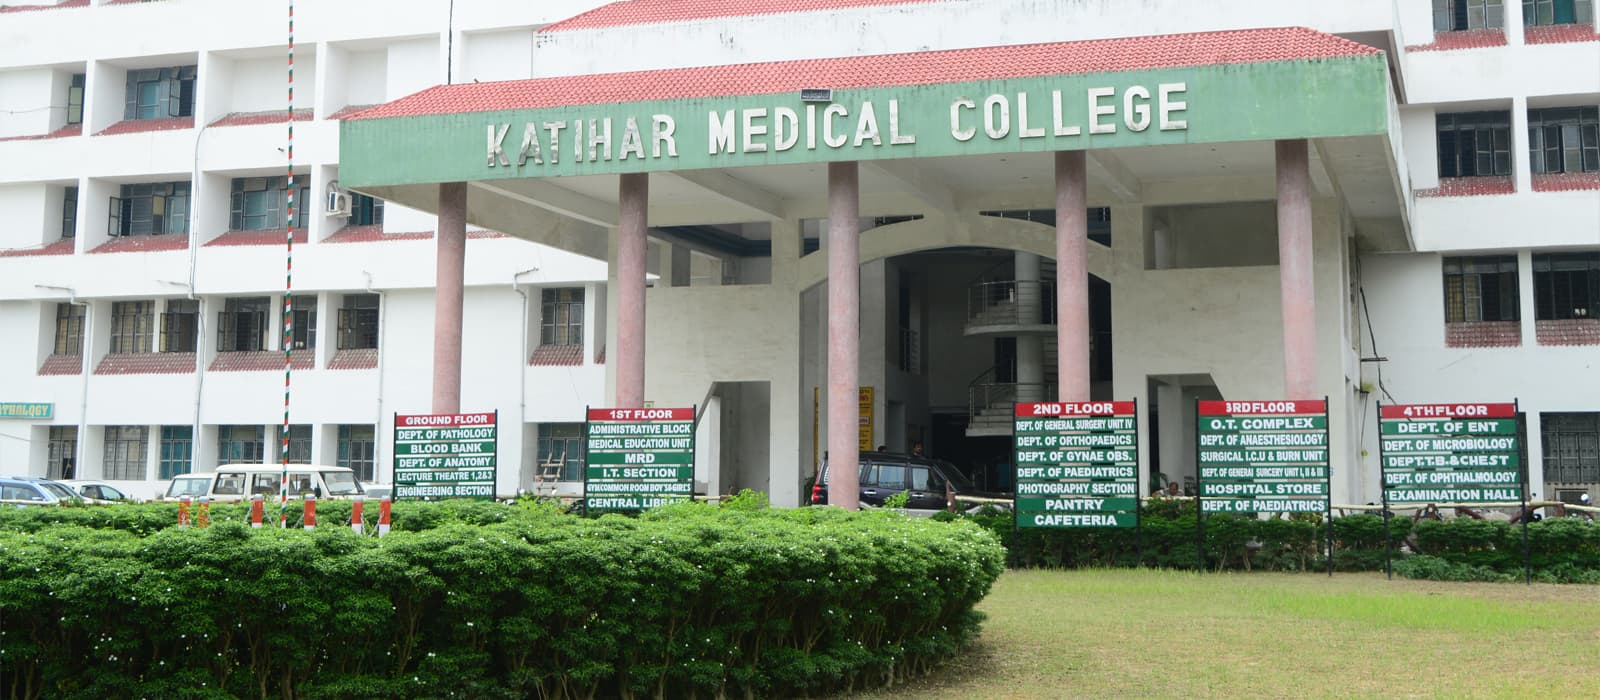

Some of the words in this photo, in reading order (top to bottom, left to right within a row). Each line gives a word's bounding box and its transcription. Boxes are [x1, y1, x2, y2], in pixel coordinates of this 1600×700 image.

[487, 114, 678, 167] KATIHAR
[708, 100, 916, 154] MEDICAL
[950, 82, 1187, 141] COLLEGE
[1033, 404, 1061, 414] 2ND
[1066, 404, 1114, 414] FLOOR
[1226, 403, 1250, 412] 3RD
[1252, 402, 1295, 412] FLOOR
[610, 410, 631, 419] 1ST
[634, 410, 672, 418] FLOOR
[406, 416, 451, 425] GROUND
[454, 415, 487, 424] FLOOR
[1016, 421, 1033, 430] DEPT.
[1036, 421, 1043, 430] OF
[1045, 420, 1074, 430] GENERAL
[1076, 420, 1105, 430] SURGERY
[1108, 419, 1124, 428] UNIT
[1125, 419, 1132, 428] IV
[1211, 420, 1238, 429] O.T.
[1242, 418, 1314, 429] COMPLEX
[590, 425, 660, 434] ADMINISTRATIVE
[663, 424, 690, 433] BLOCK
[1398, 423, 1439, 432] DEPT.
[1444, 422, 1463, 432] OF
[1468, 422, 1498, 432] ENT
[398, 430, 423, 439] DEPT.
[426, 430, 439, 439] OF
[441, 428, 493, 438] PATHOLOGY
[589, 439, 622, 448] MEDICAL
[625, 439, 670, 448] EDUCATION
[672, 439, 690, 448] UNIT
[1018, 437, 1042, 446] DEPT.
[1045, 437, 1057, 446] OF
[1060, 435, 1131, 445] ORTHOPAEDICS
[1201, 435, 1224, 445] DEPT.
[1227, 435, 1238, 445] OF
[1240, 434, 1323, 445] ANAESTHESIOLOGY
[1385, 441, 1413, 450] DEPT.
[1416, 440, 1430, 450] OF
[1433, 438, 1514, 450] MICROBIOLOGY
[411, 444, 448, 453] BLOOD
[452, 443, 482, 452] BANK
[625, 454, 655, 463] MRD
[1018, 452, 1046, 461] DEPT.
[1050, 452, 1063, 461] OF
[1067, 452, 1104, 461] GYNAE
[1107, 451, 1132, 461] OBS.
[1201, 452, 1243, 461] SURGICAL
[1268, 451, 1274, 461] &
[1277, 451, 1300, 461] BURN
[1303, 451, 1323, 460] UNIT
[400, 459, 426, 467] DEPT.
[429, 458, 442, 466] OF
[444, 457, 490, 466] ANATOMY
[397, 472, 432, 481] LECTURE
[435, 472, 469, 480] THEATRE
[603, 469, 620, 477] I.T.
[624, 468, 676, 477] SECTION
[1018, 468, 1045, 477] DEPT.
[1048, 468, 1062, 477] OF
[1064, 467, 1133, 477] PAEDIATRICS
[1202, 468, 1218, 477] DEPT.
[1220, 468, 1227, 477] OF
[1285, 468, 1298, 477] UNIT
[1387, 473, 1412, 483] DEPT.
[1415, 473, 1427, 483] OF
[1430, 472, 1516, 482] OPHTHALMOLOGY
[397, 486, 453, 496] ENGINEERING
[455, 486, 492, 496] SECTION
[1018, 484, 1089, 493] PHOTOGRAPHY
[1092, 484, 1134, 493] SECTION
[1206, 484, 1272, 494] HOSPITAL
[1276, 484, 1321, 493] STORE
[1389, 490, 1480, 500] EXAMINATION
[1484, 489, 1518, 499] HALL
[588, 498, 639, 507] CENTRAL
[1046, 500, 1104, 510] PANTRY
[1202, 501, 1232, 511] DEPT.
[1235, 501, 1249, 511] OF
[1253, 501, 1324, 511] PAEDIATRICS
[1035, 515, 1117, 526] CAFETERIA
